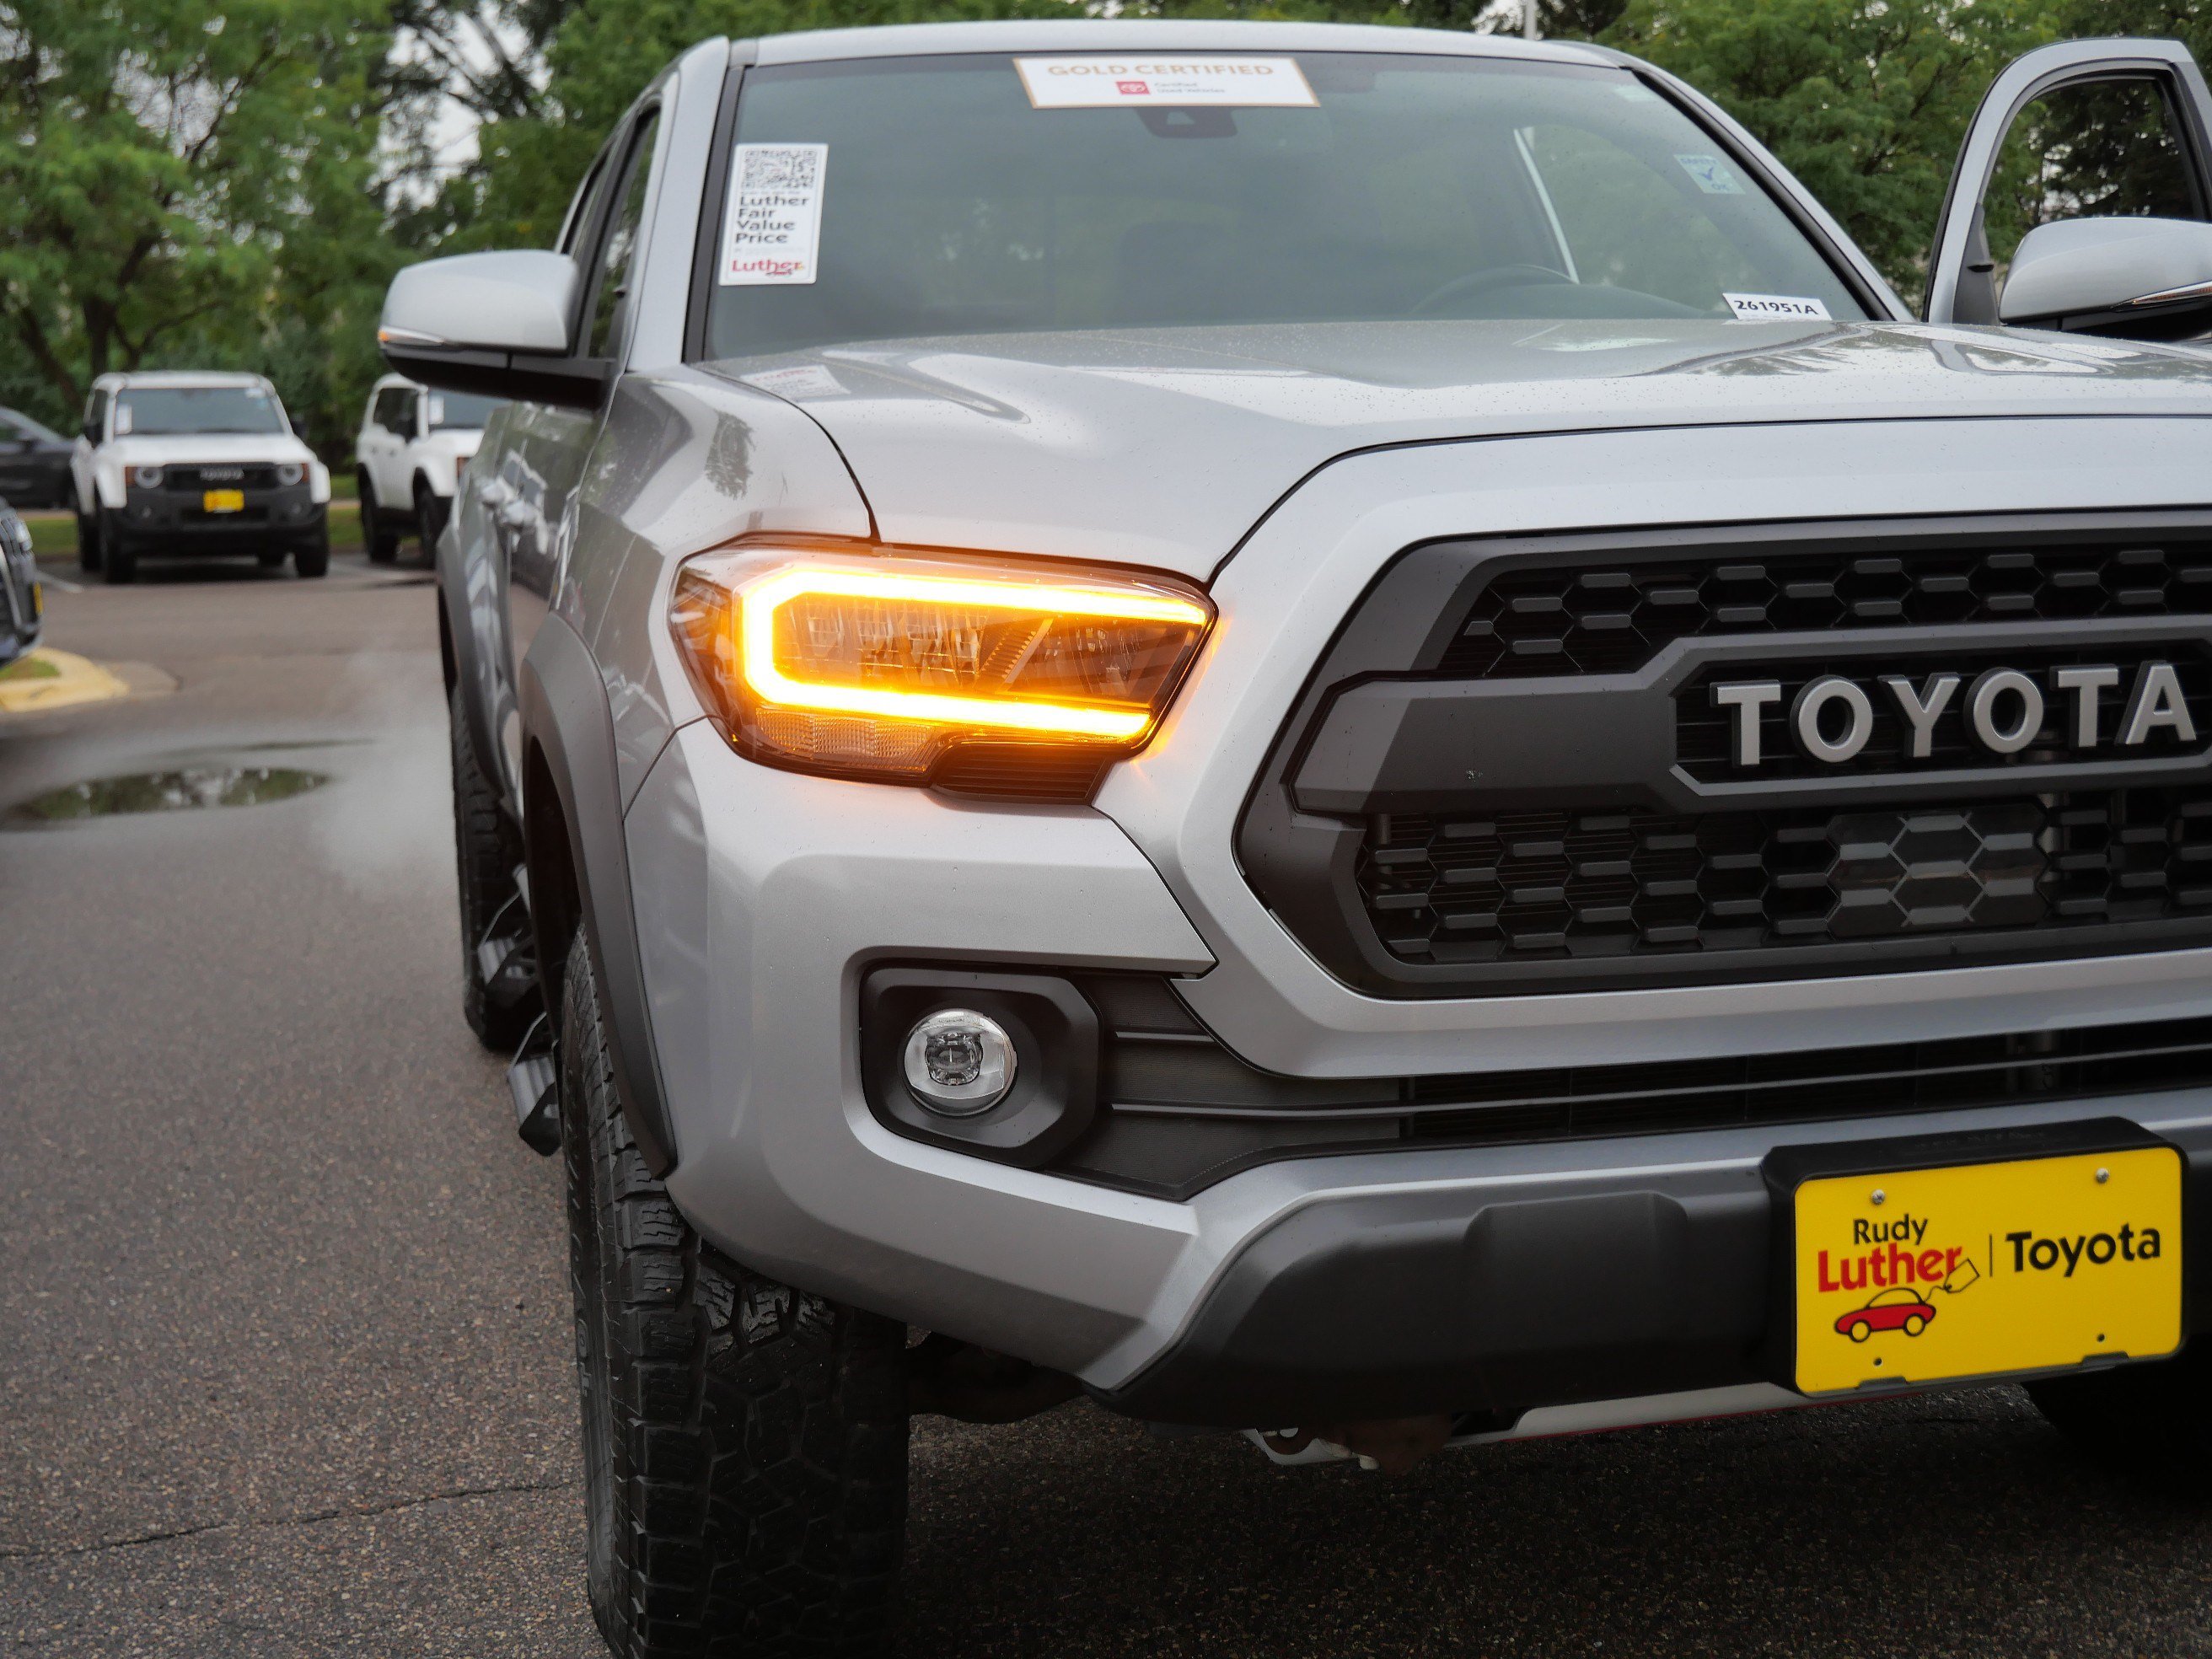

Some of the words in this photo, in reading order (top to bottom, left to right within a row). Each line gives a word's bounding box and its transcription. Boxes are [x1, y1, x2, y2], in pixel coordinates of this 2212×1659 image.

[1048, 65, 1128, 76] GOLD
[1135, 64, 1274, 76] CERTIFIED
[740, 196, 809, 207] Luther
[738, 208, 776, 218] Fair
[737, 220, 795, 230] Value
[735, 233, 788, 244] Price
[732, 259, 803, 272] Luther
[1733, 300, 1819, 314] 261951A
[1710, 660, 2197, 766] TOYOTA
[1854, 1214, 1928, 1246] Rudy
[1817, 1243, 1962, 1292] Luther
[2005, 1223, 2161, 1277] Toyota
